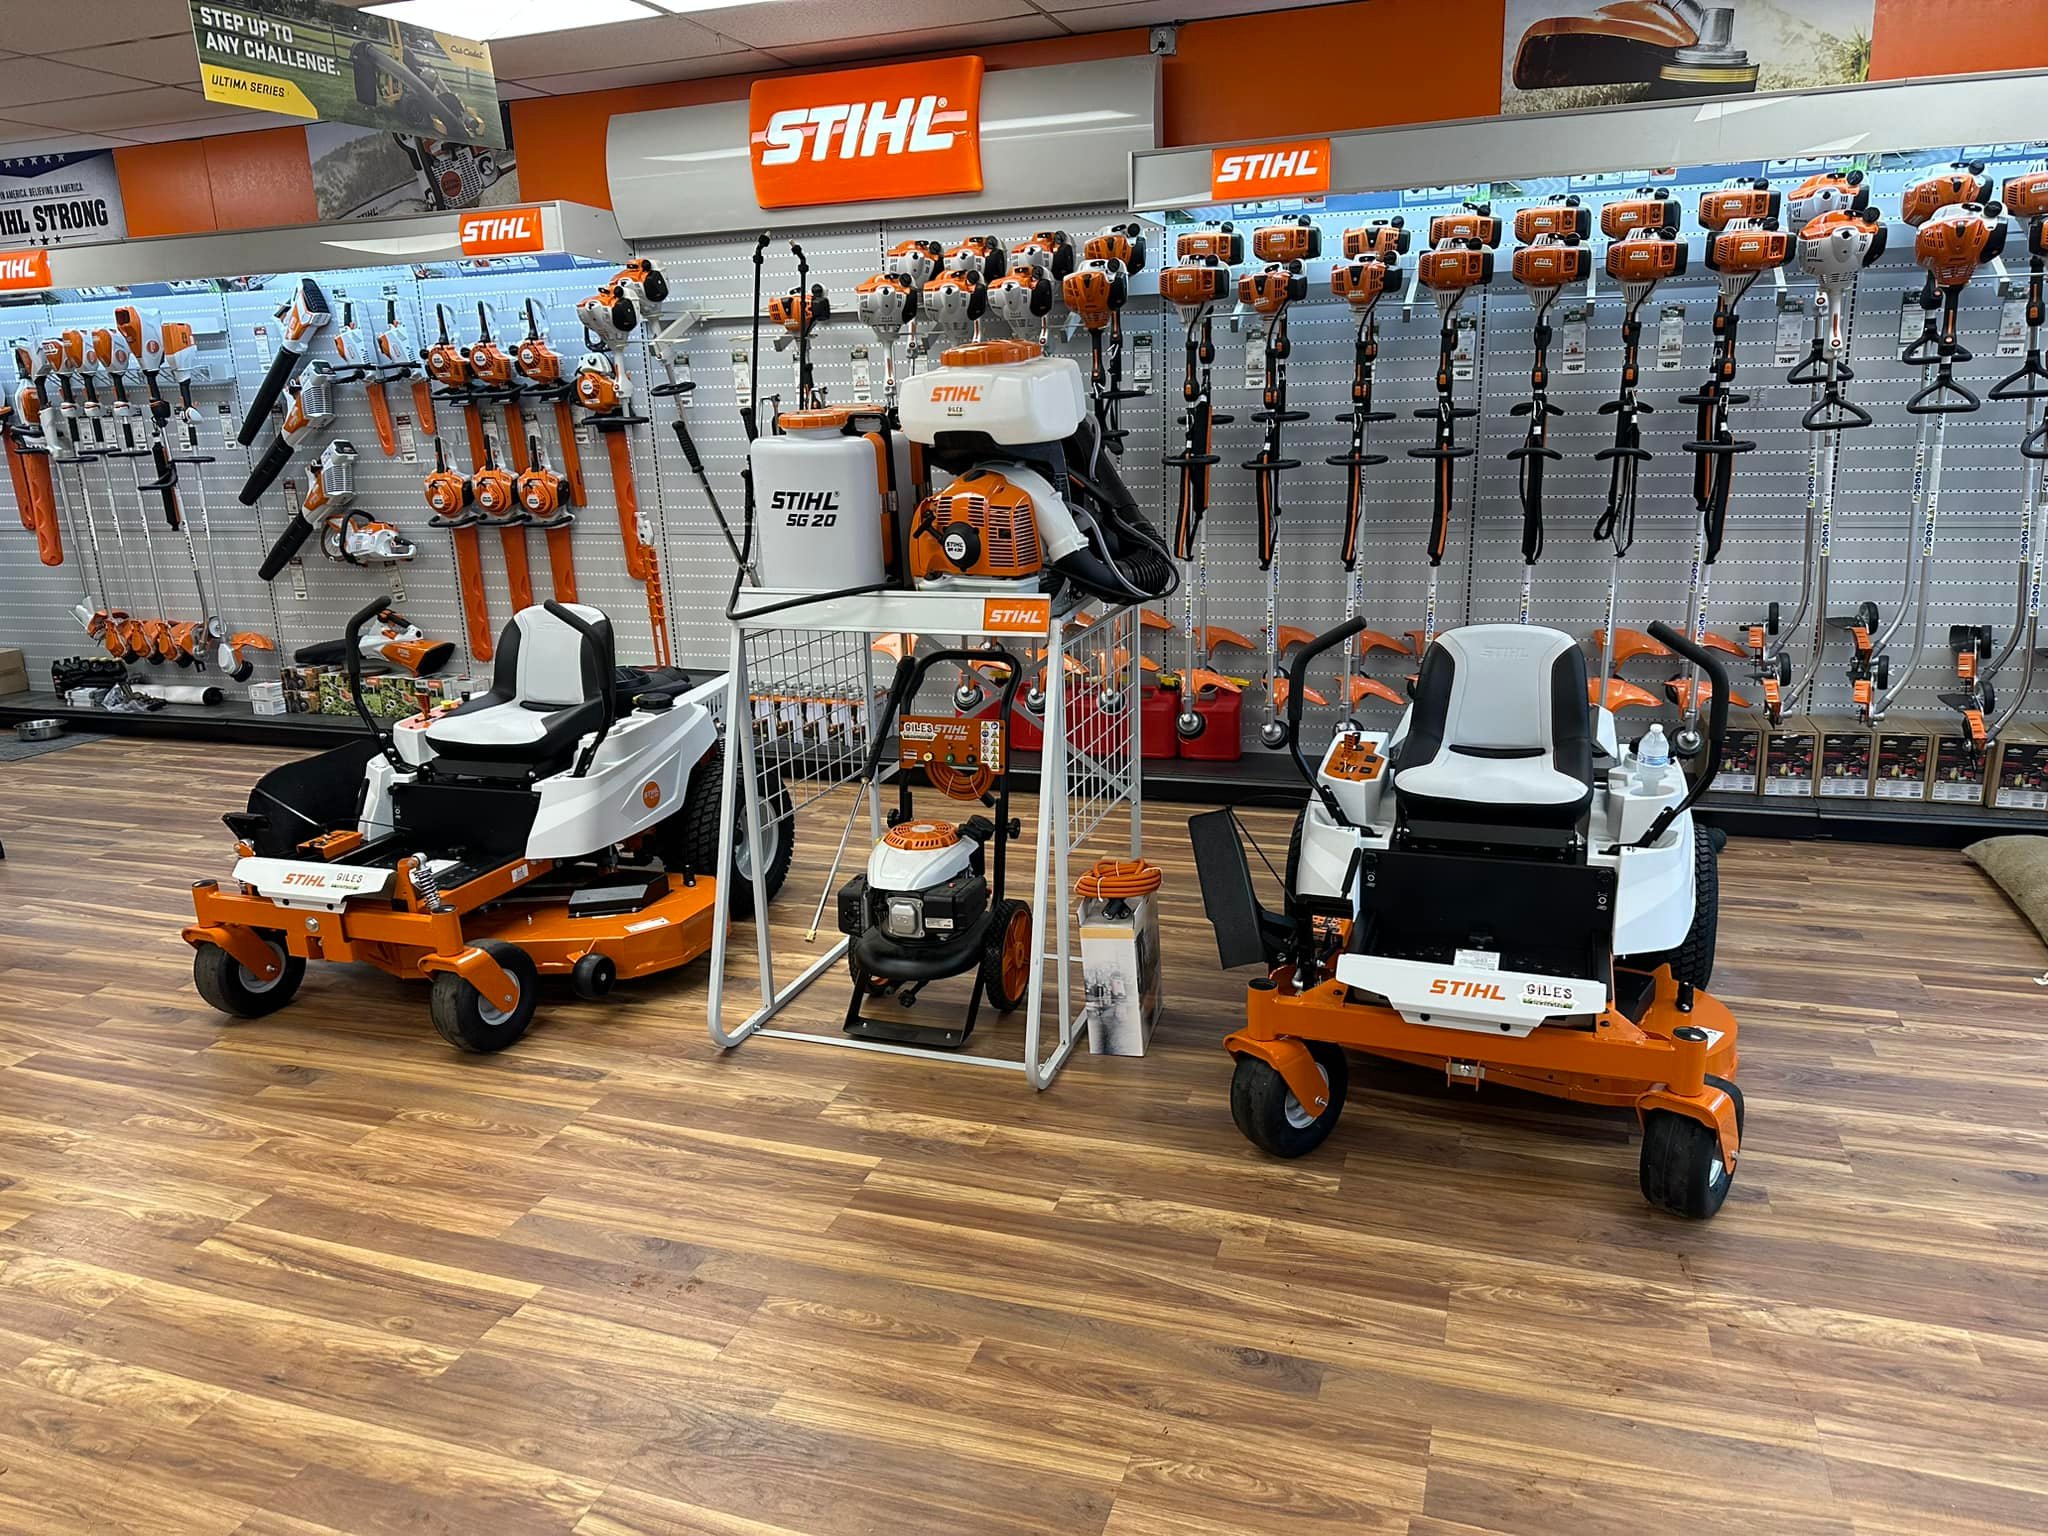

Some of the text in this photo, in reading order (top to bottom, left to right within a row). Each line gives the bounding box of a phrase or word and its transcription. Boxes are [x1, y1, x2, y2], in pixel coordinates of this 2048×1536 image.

[200, 6, 293, 43] STEP UP TO
[206, 31, 341, 76] ANY CHALLENGE.
[212, 74, 285, 97] ULTIMA SERIES
[761, 95, 954, 166] STIHL
[1216, 150, 1319, 183] STIHL
[0, 198, 109, 236] IHL STRONG
[462, 217, 531, 243] STIHL
[0, 258, 37, 280] TIHL
[930, 385, 982, 403] STIHL
[771, 491, 839, 511] STIHL
[786, 513, 837, 527] SG 20
[988, 609, 1042, 624] STIHL
[905, 723, 969, 735] GILES STIHL
[282, 873, 326, 888] STIHL
[336, 873, 363, 884] GILES
[1429, 979, 1573, 1001] STIHL GILES
